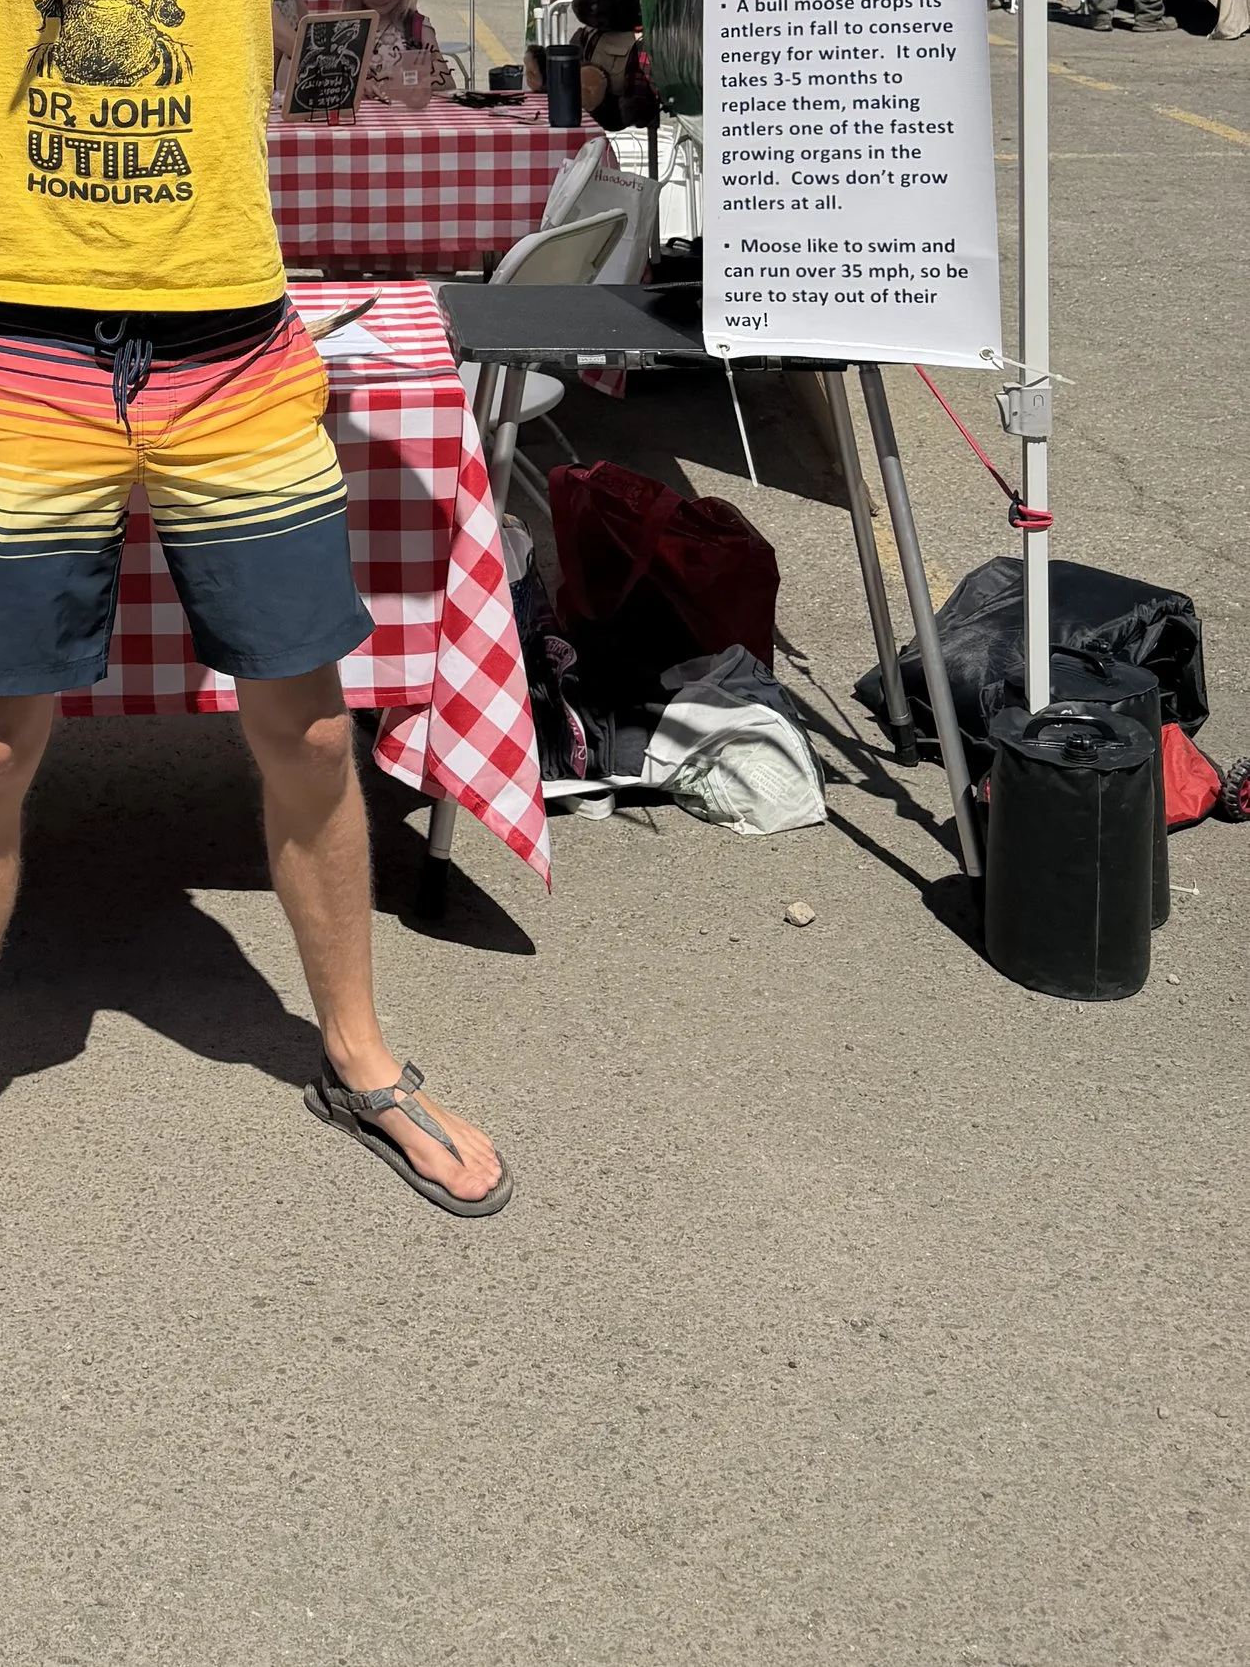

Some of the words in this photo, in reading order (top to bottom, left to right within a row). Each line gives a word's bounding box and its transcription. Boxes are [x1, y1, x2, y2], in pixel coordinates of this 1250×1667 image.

[90, 94, 192, 128] JOHN
[27, 130, 192, 180] UTILA
[27, 173, 193, 204] HONDURAS
[594, 169, 644, 192] Handouts
[741, 239, 802, 253] Moose
[807, 238, 838, 253] like
[843, 240, 863, 253] to
[868, 238, 916, 253] swim
[921, 238, 955, 253] and
[724, 267, 754, 278] can
[760, 267, 790, 278] run
[796, 267, 836, 278] over
[841, 264, 863, 278] 35
[869, 263, 915, 282] mph,
[920, 267, 941, 278] so
[946, 263, 968, 279] be
[724, 291, 762, 302] sure
[767, 289, 787, 302] to
[792, 289, 829, 306] stay
[834, 290, 865, 303] out
[870, 288, 889, 303] of
[894, 288, 938, 304] their
[725, 312, 768, 331] way!
